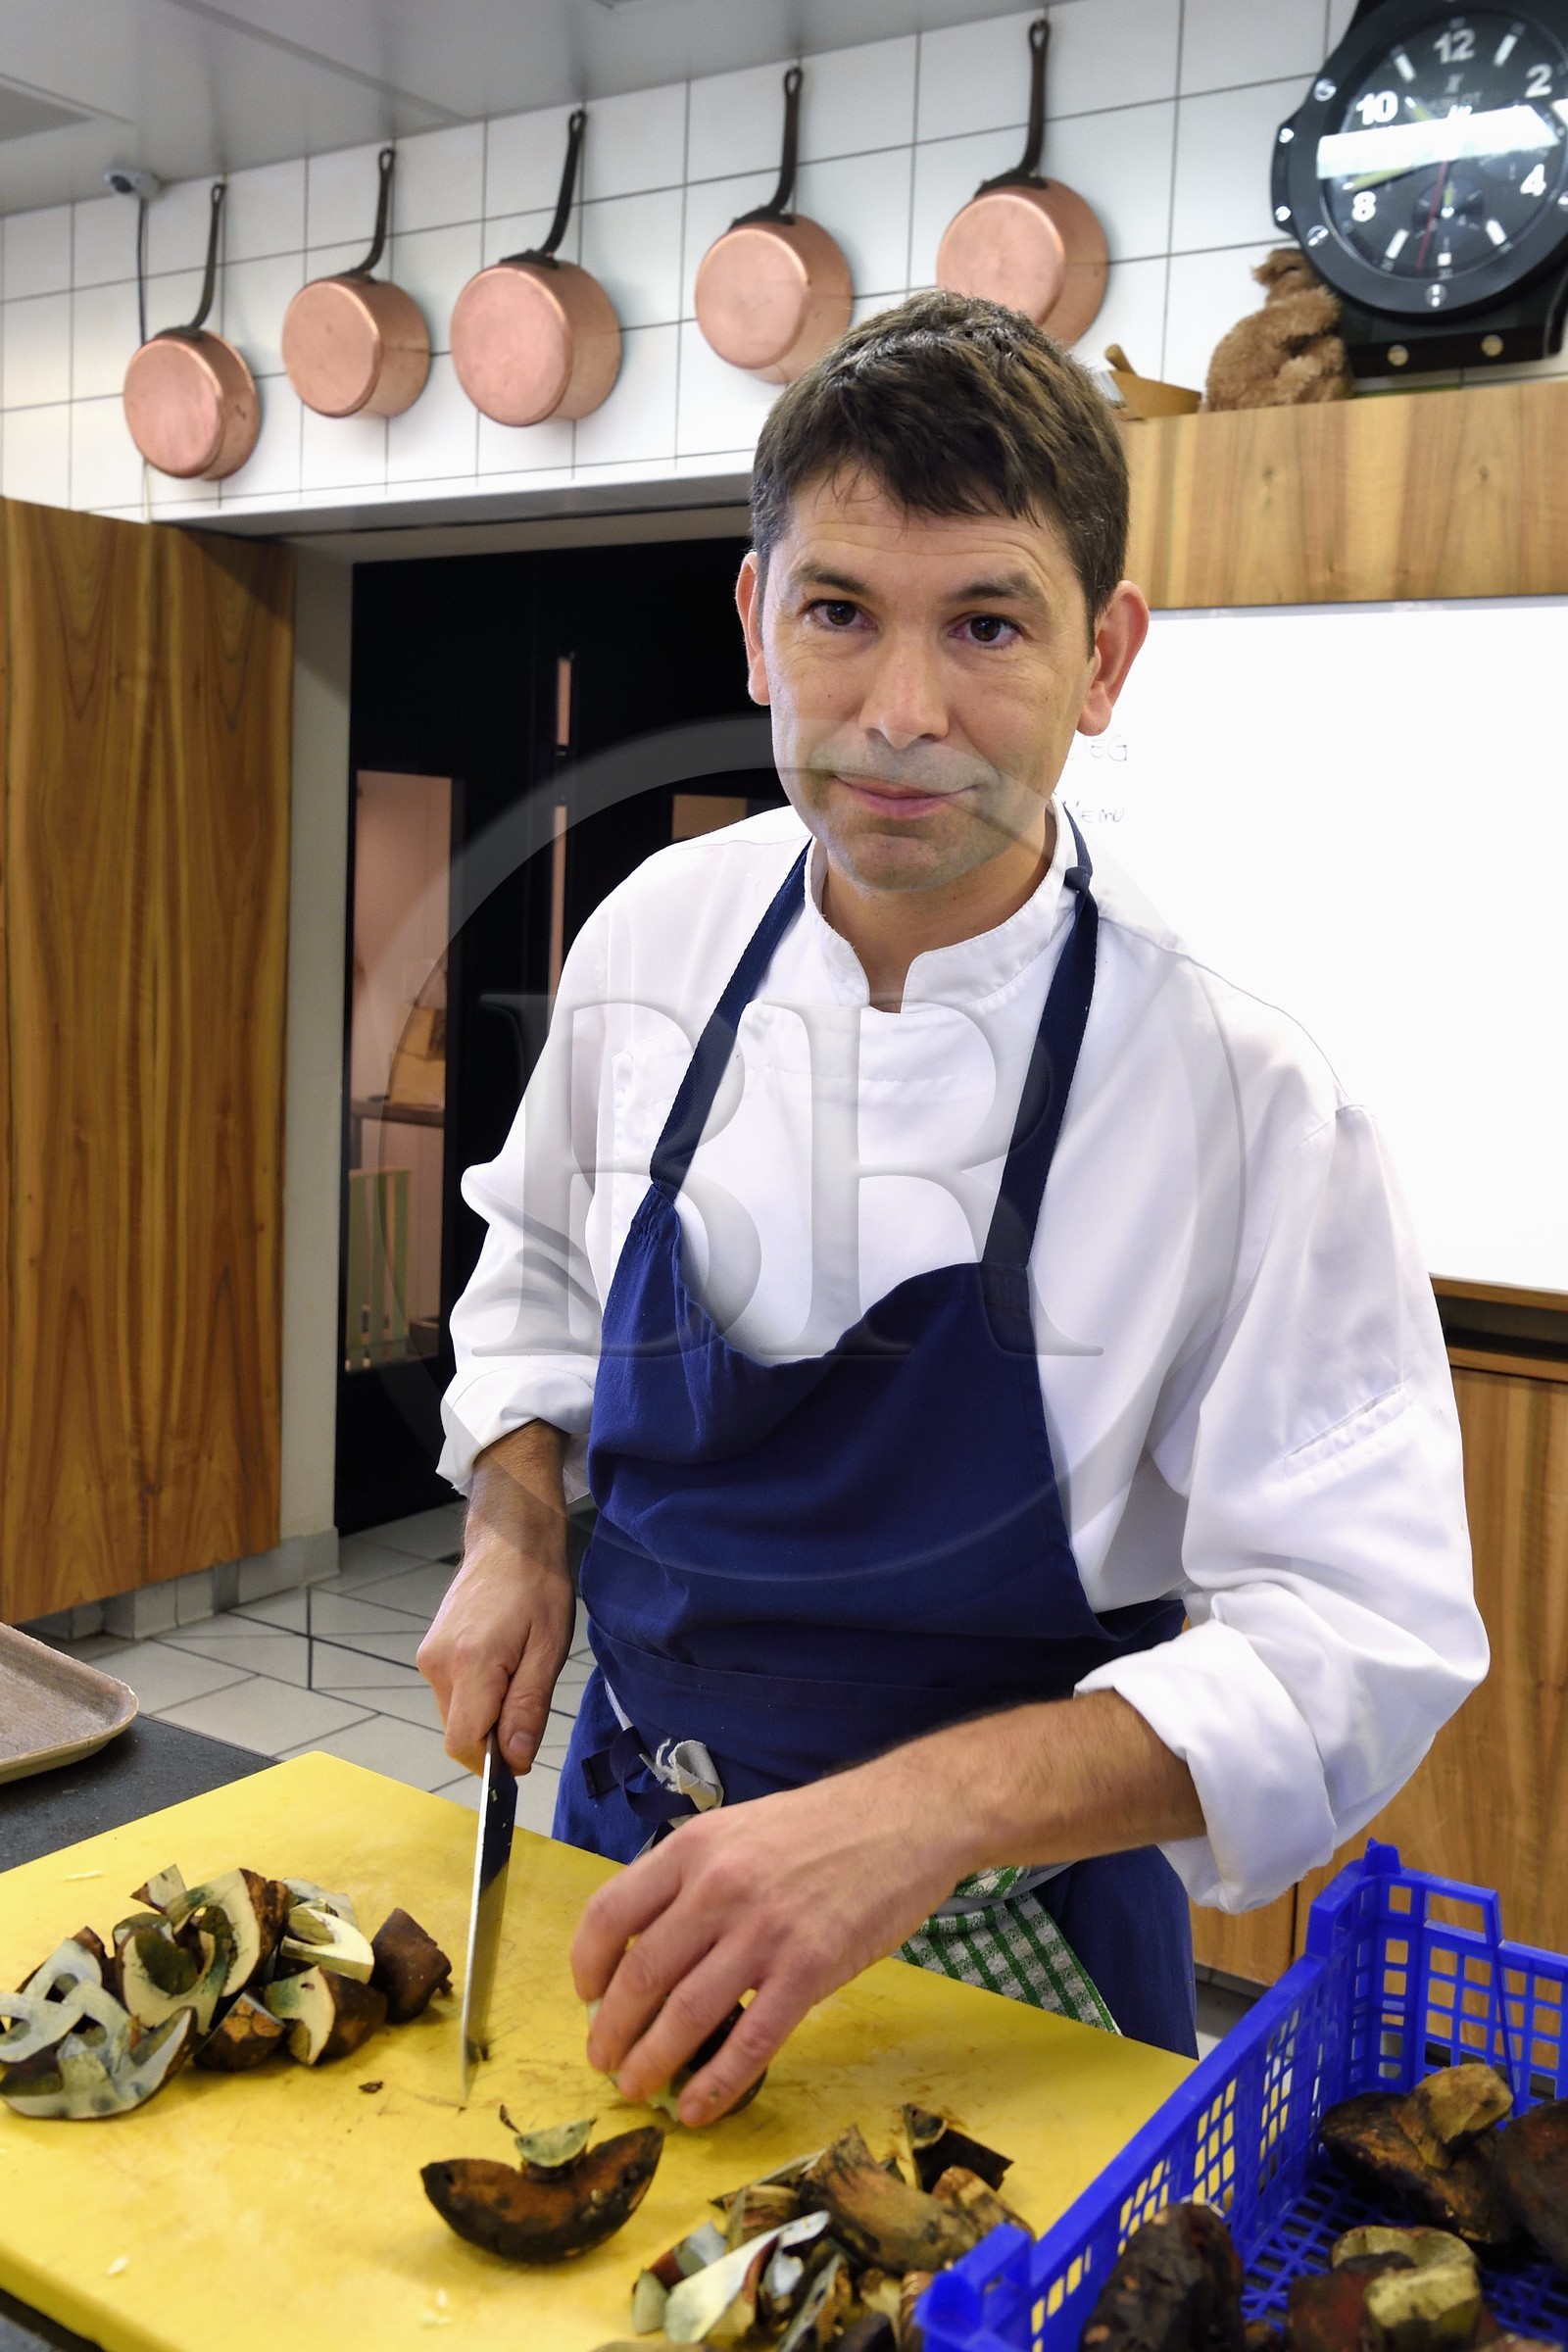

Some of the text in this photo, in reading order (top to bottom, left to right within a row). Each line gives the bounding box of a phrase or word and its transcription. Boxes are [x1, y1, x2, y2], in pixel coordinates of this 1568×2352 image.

[1434, 28, 1475, 64] 12
[1526, 64, 1552, 98] 2
[1356, 90, 1398, 125] 10
[1520, 164, 1546, 196] 4
[1351, 190, 1377, 222] 8
